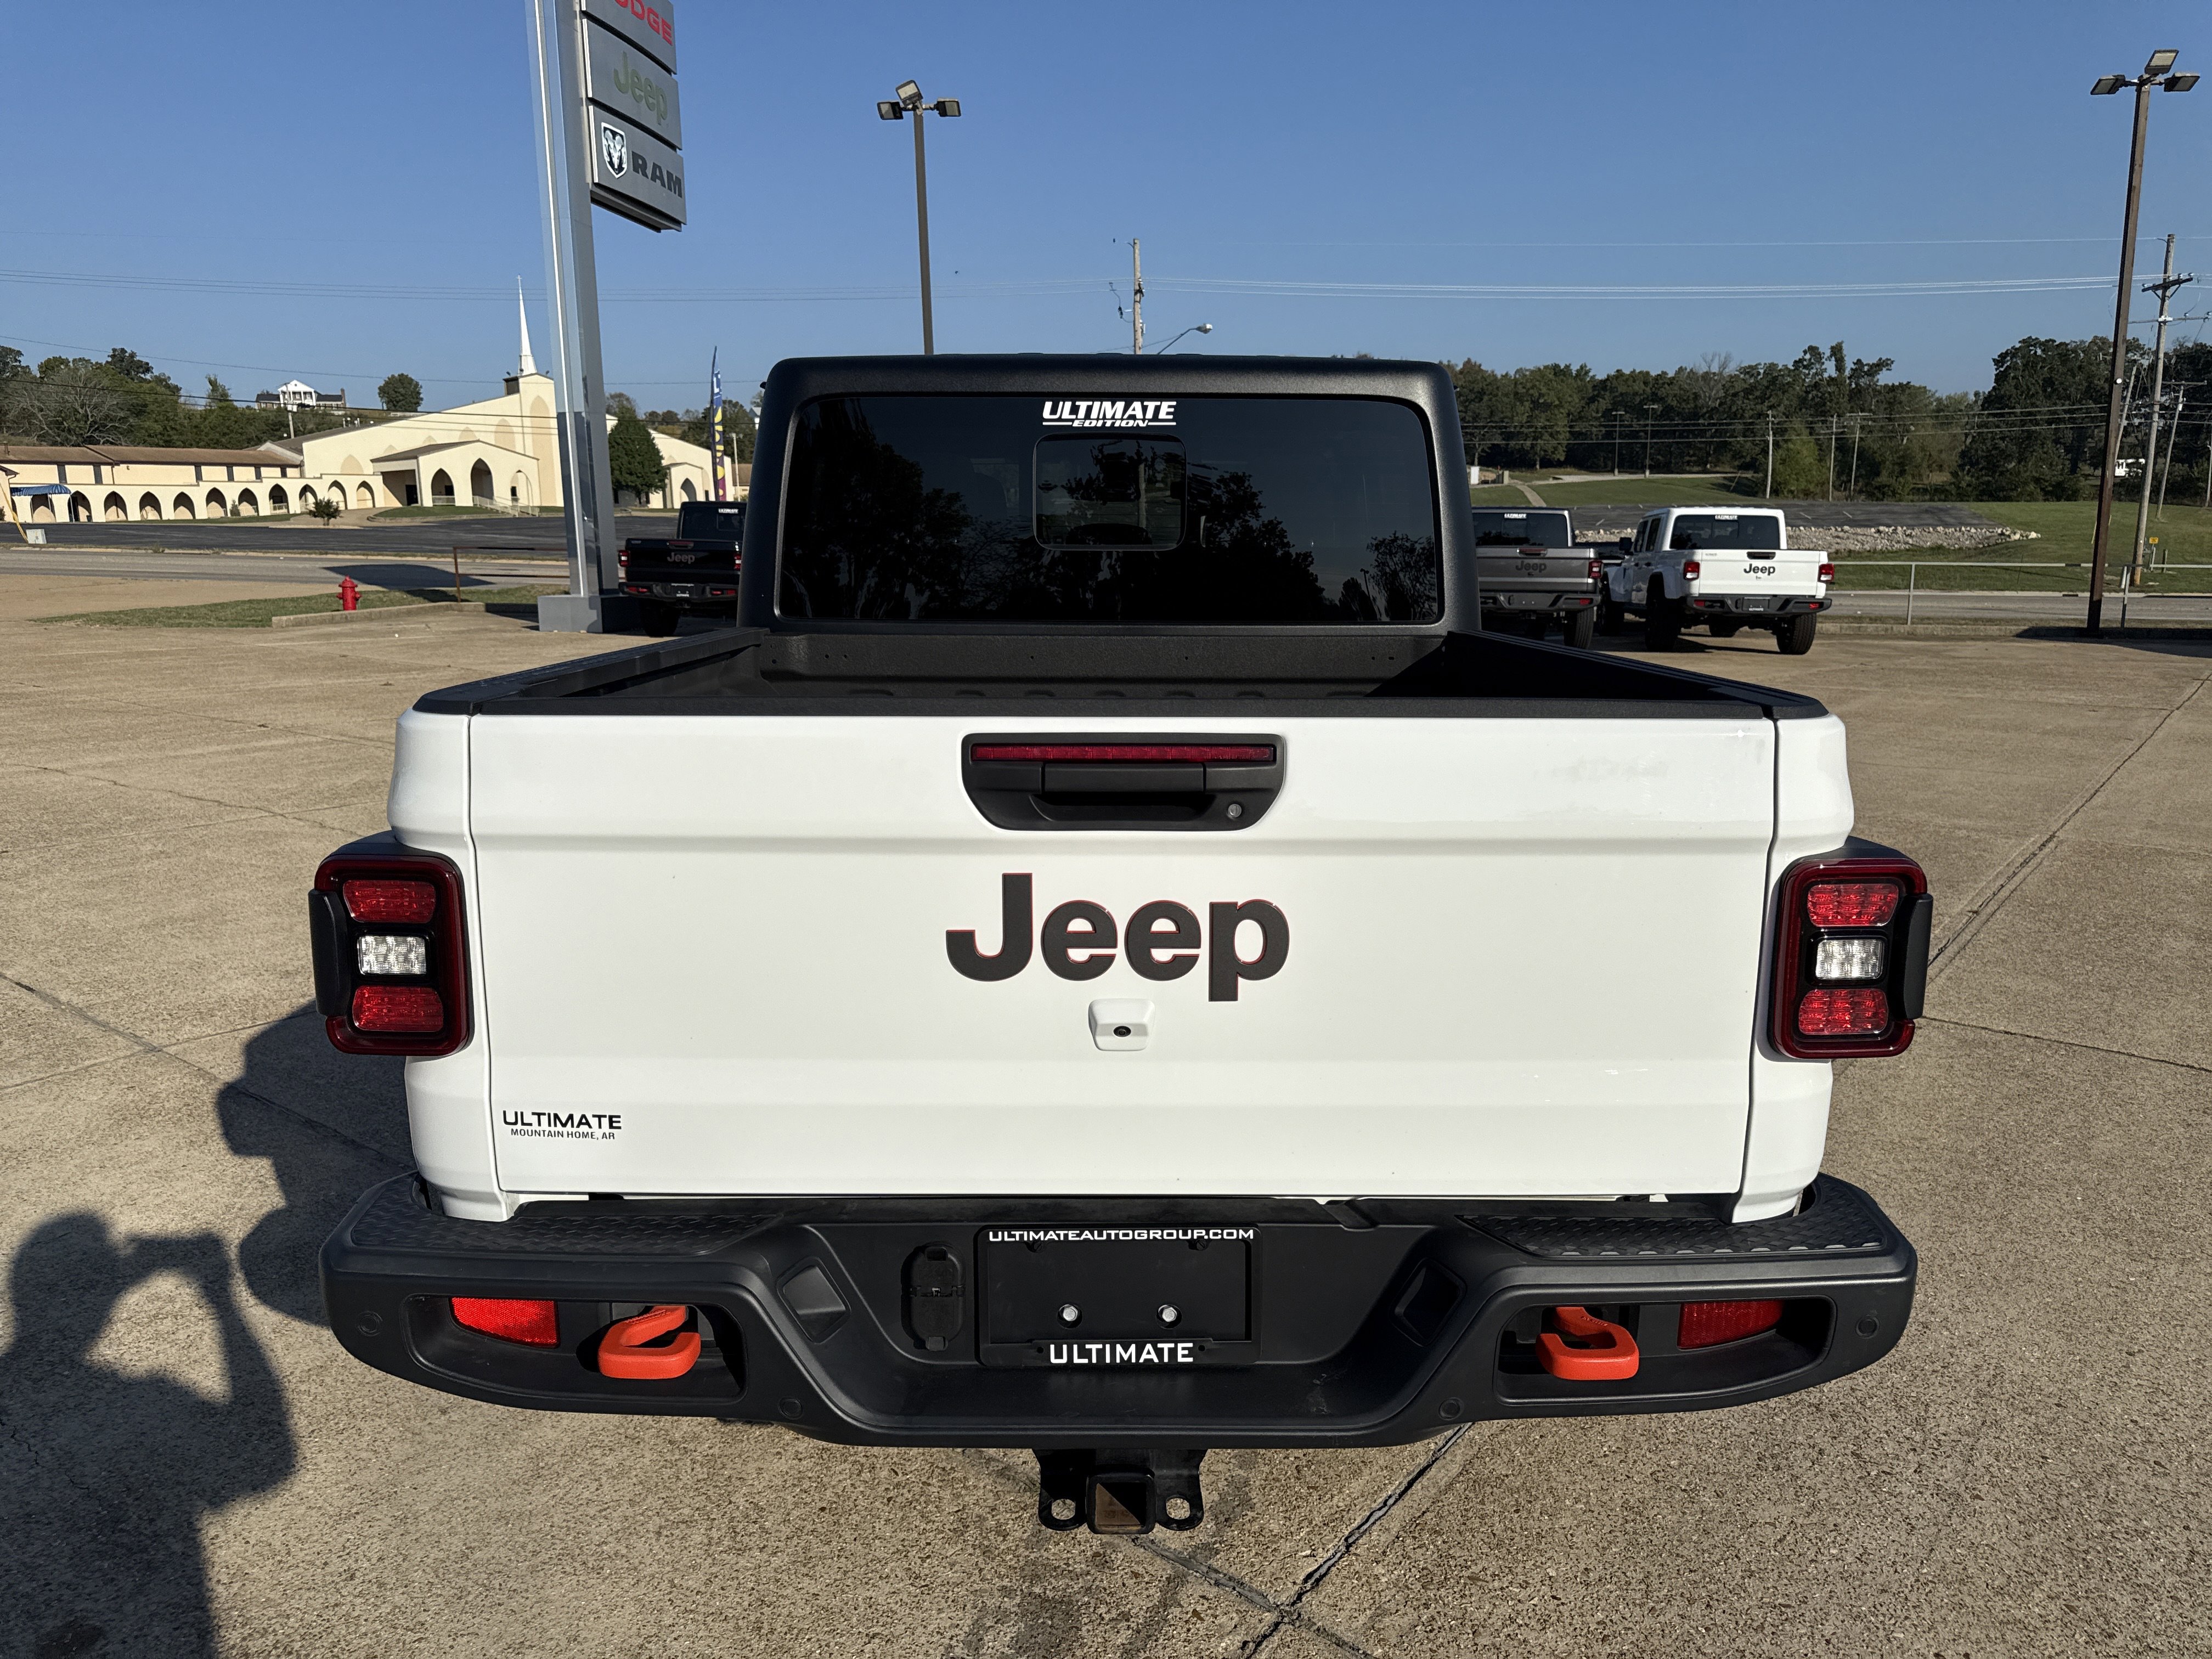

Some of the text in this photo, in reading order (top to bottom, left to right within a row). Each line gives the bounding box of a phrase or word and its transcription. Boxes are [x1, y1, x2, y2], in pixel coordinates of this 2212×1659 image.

[613, 51, 667, 126] Jeep
[631, 150, 682, 198] RAM
[1042, 401, 1177, 419] ULTIMATE
[667, 552, 695, 564] Jeep
[1515, 561, 1547, 573] Jeep
[1743, 563, 1776, 575] Jeep
[946, 873, 1290, 1002] Jeep
[503, 1110, 622, 1130] ULTIMATE
[511, 1128, 615, 1141] MOUNTAIN HOME, AR
[989, 1229, 1254, 1242] ULTIMATEAUTOGROUP.COM
[1049, 1342, 1193, 1364] ULTIMATE
